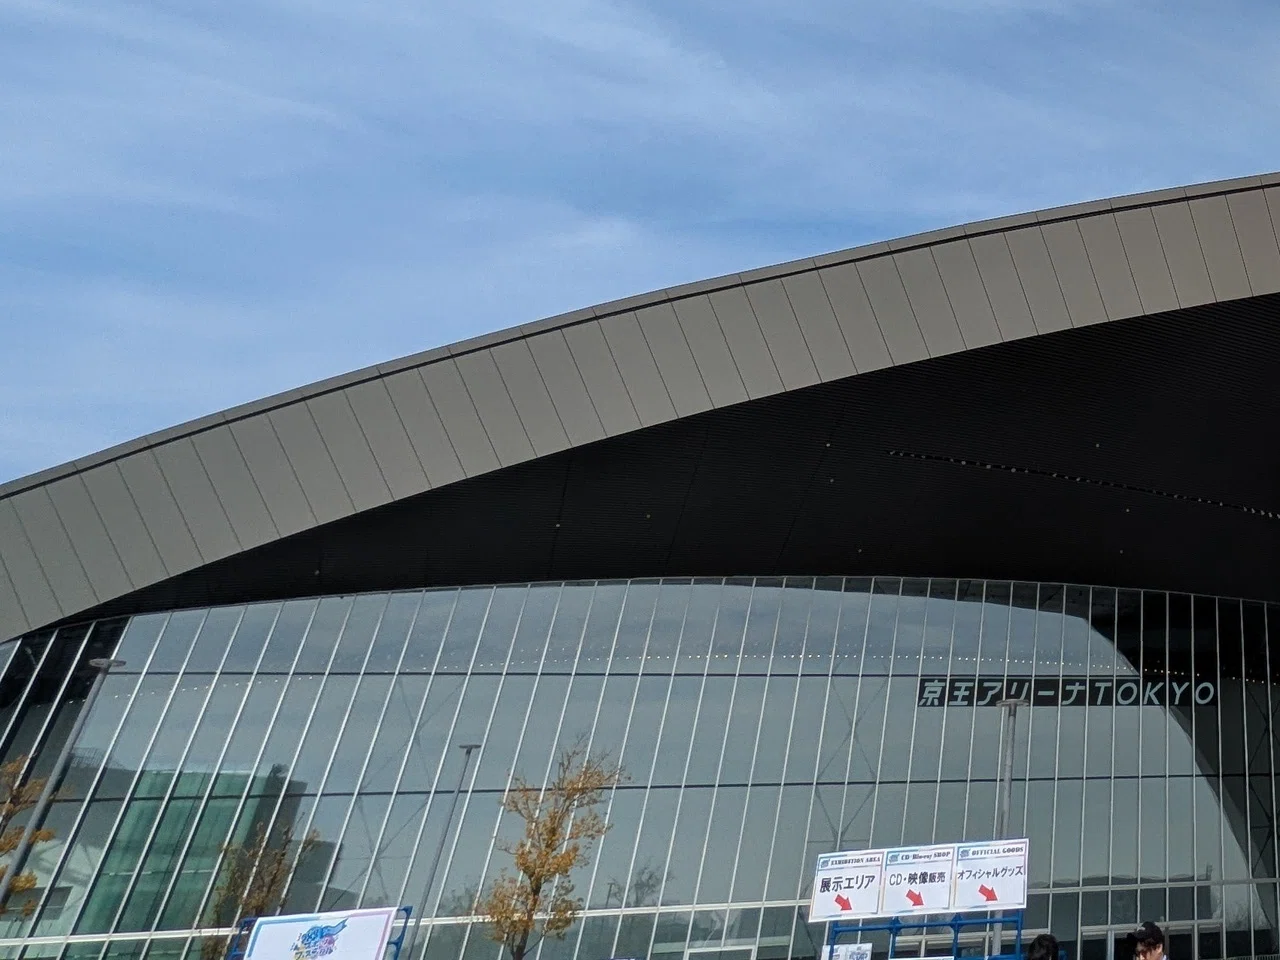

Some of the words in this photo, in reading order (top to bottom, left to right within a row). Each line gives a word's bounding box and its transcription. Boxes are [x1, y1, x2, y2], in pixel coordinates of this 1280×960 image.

[1002, 846, 1024, 854] GOODS
[889, 871, 946, 886] CD・映像販売
[957, 865, 1024, 880] オフィシャルグッズ
[819, 874, 875, 894] 展示エリア
